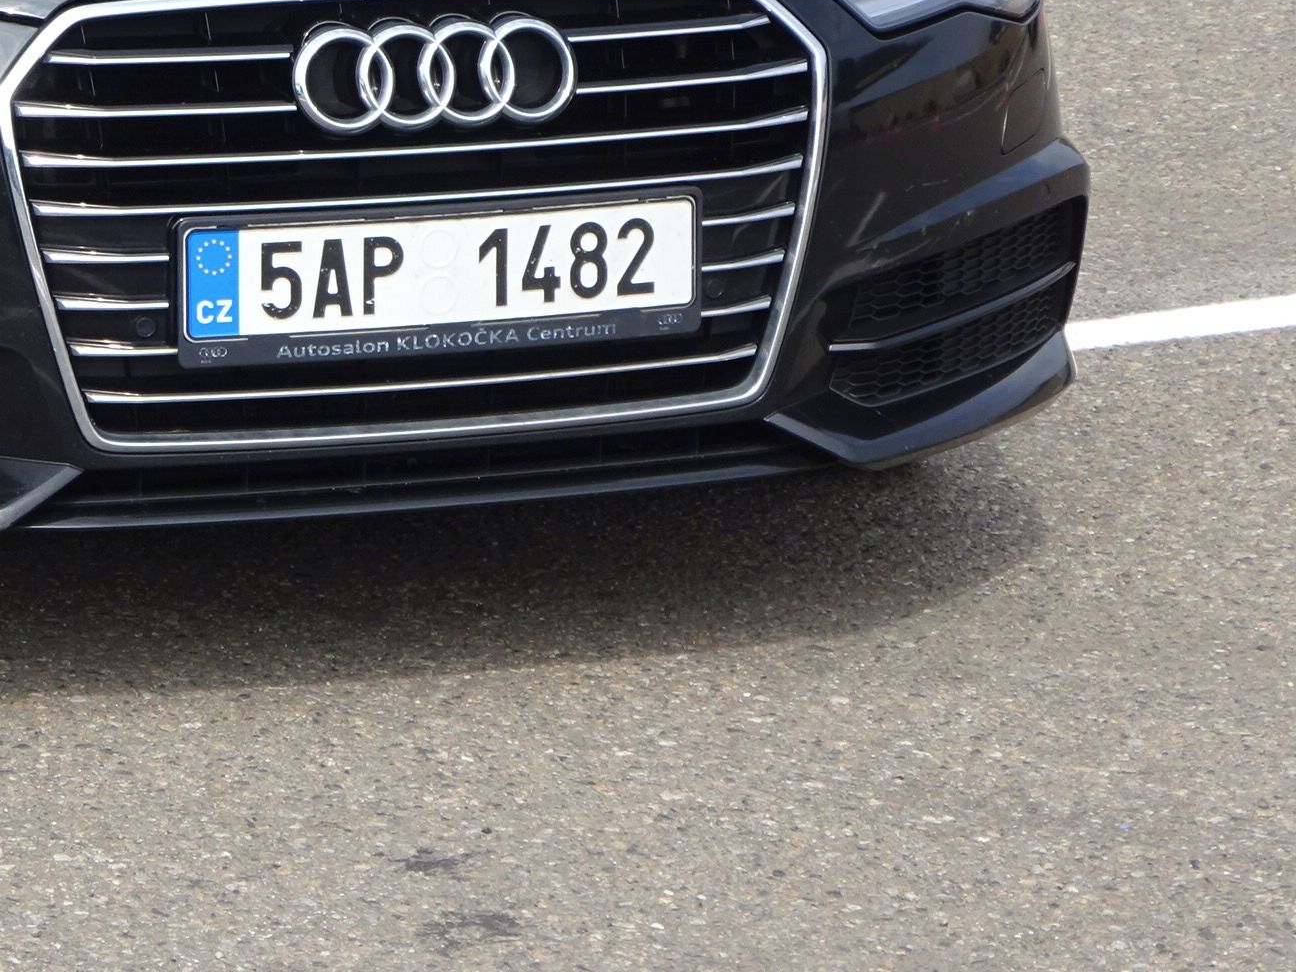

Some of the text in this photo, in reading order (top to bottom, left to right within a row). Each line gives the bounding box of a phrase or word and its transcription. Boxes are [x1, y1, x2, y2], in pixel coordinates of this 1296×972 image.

[260, 218, 655, 319] 5AP 1482
[195, 298, 233, 325] CZ
[276, 323, 617, 359] Autosalon KLOKOČKA Centrum
